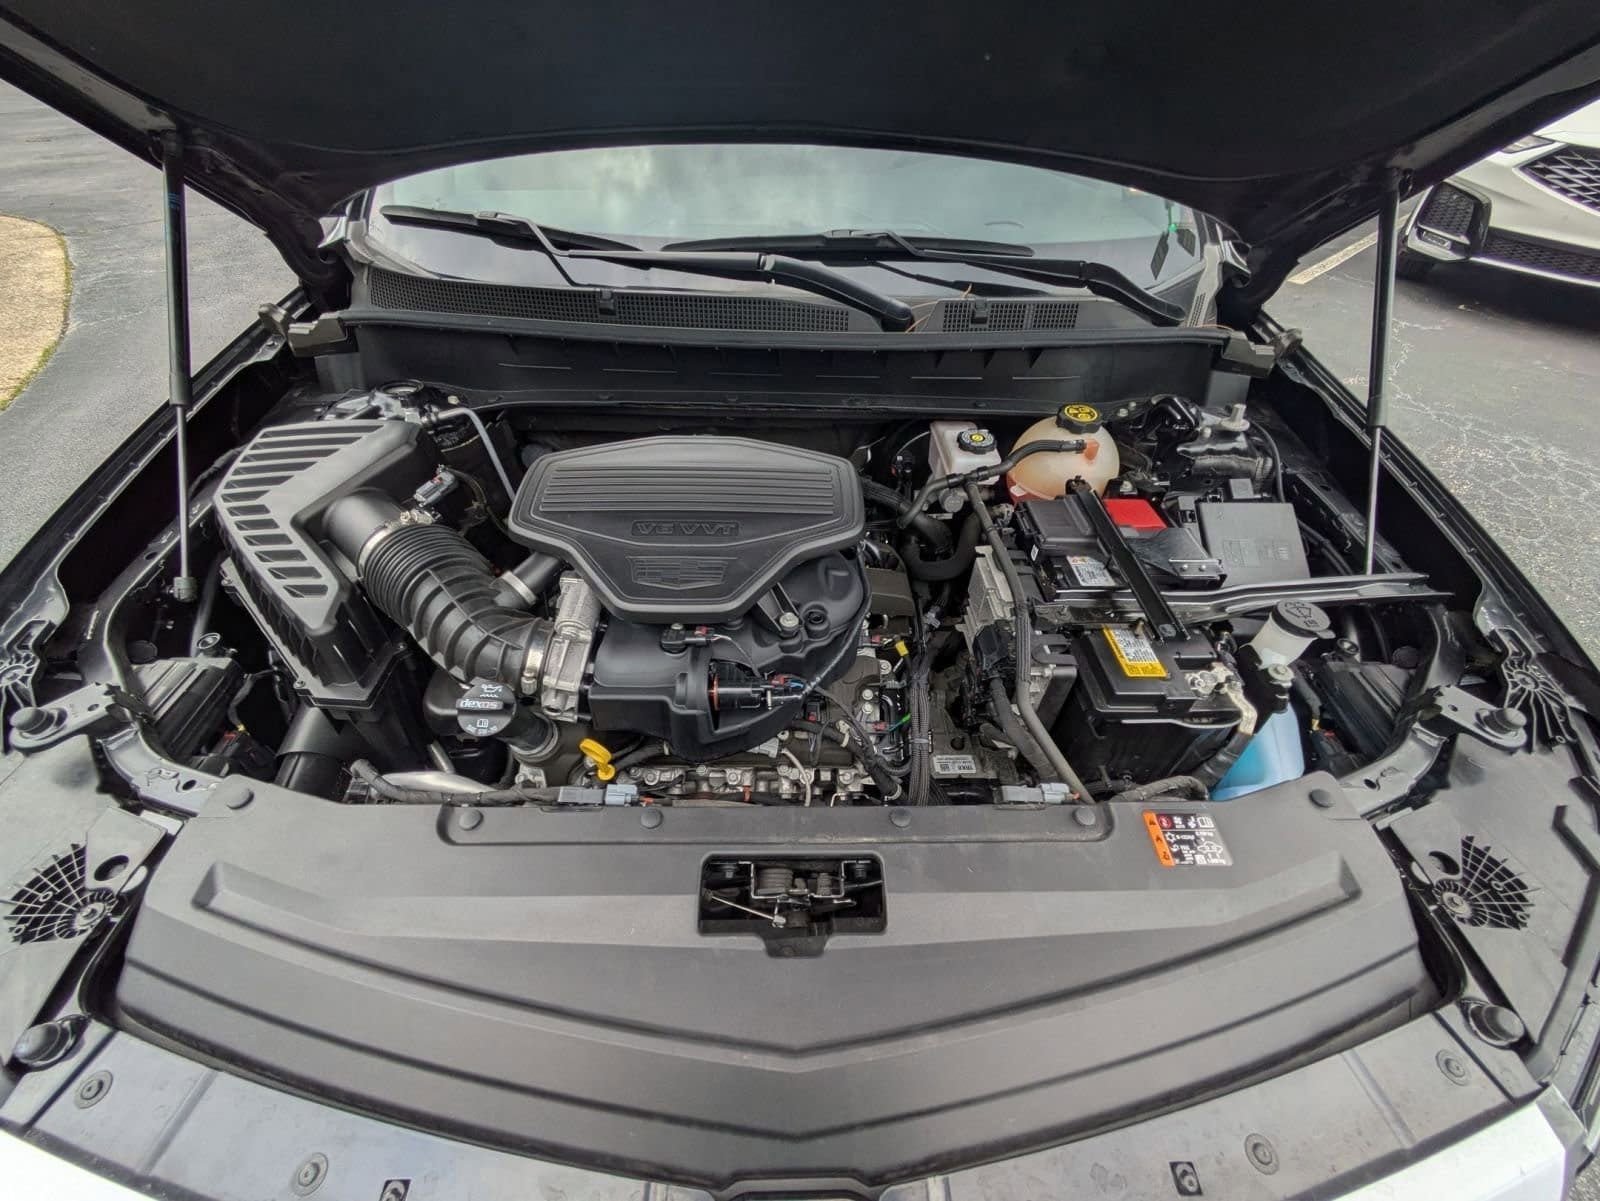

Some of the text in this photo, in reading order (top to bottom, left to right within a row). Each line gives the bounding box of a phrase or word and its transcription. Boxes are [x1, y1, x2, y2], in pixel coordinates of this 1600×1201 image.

[637, 522, 736, 535] V6 VVT
[460, 699, 498, 708] dexos
